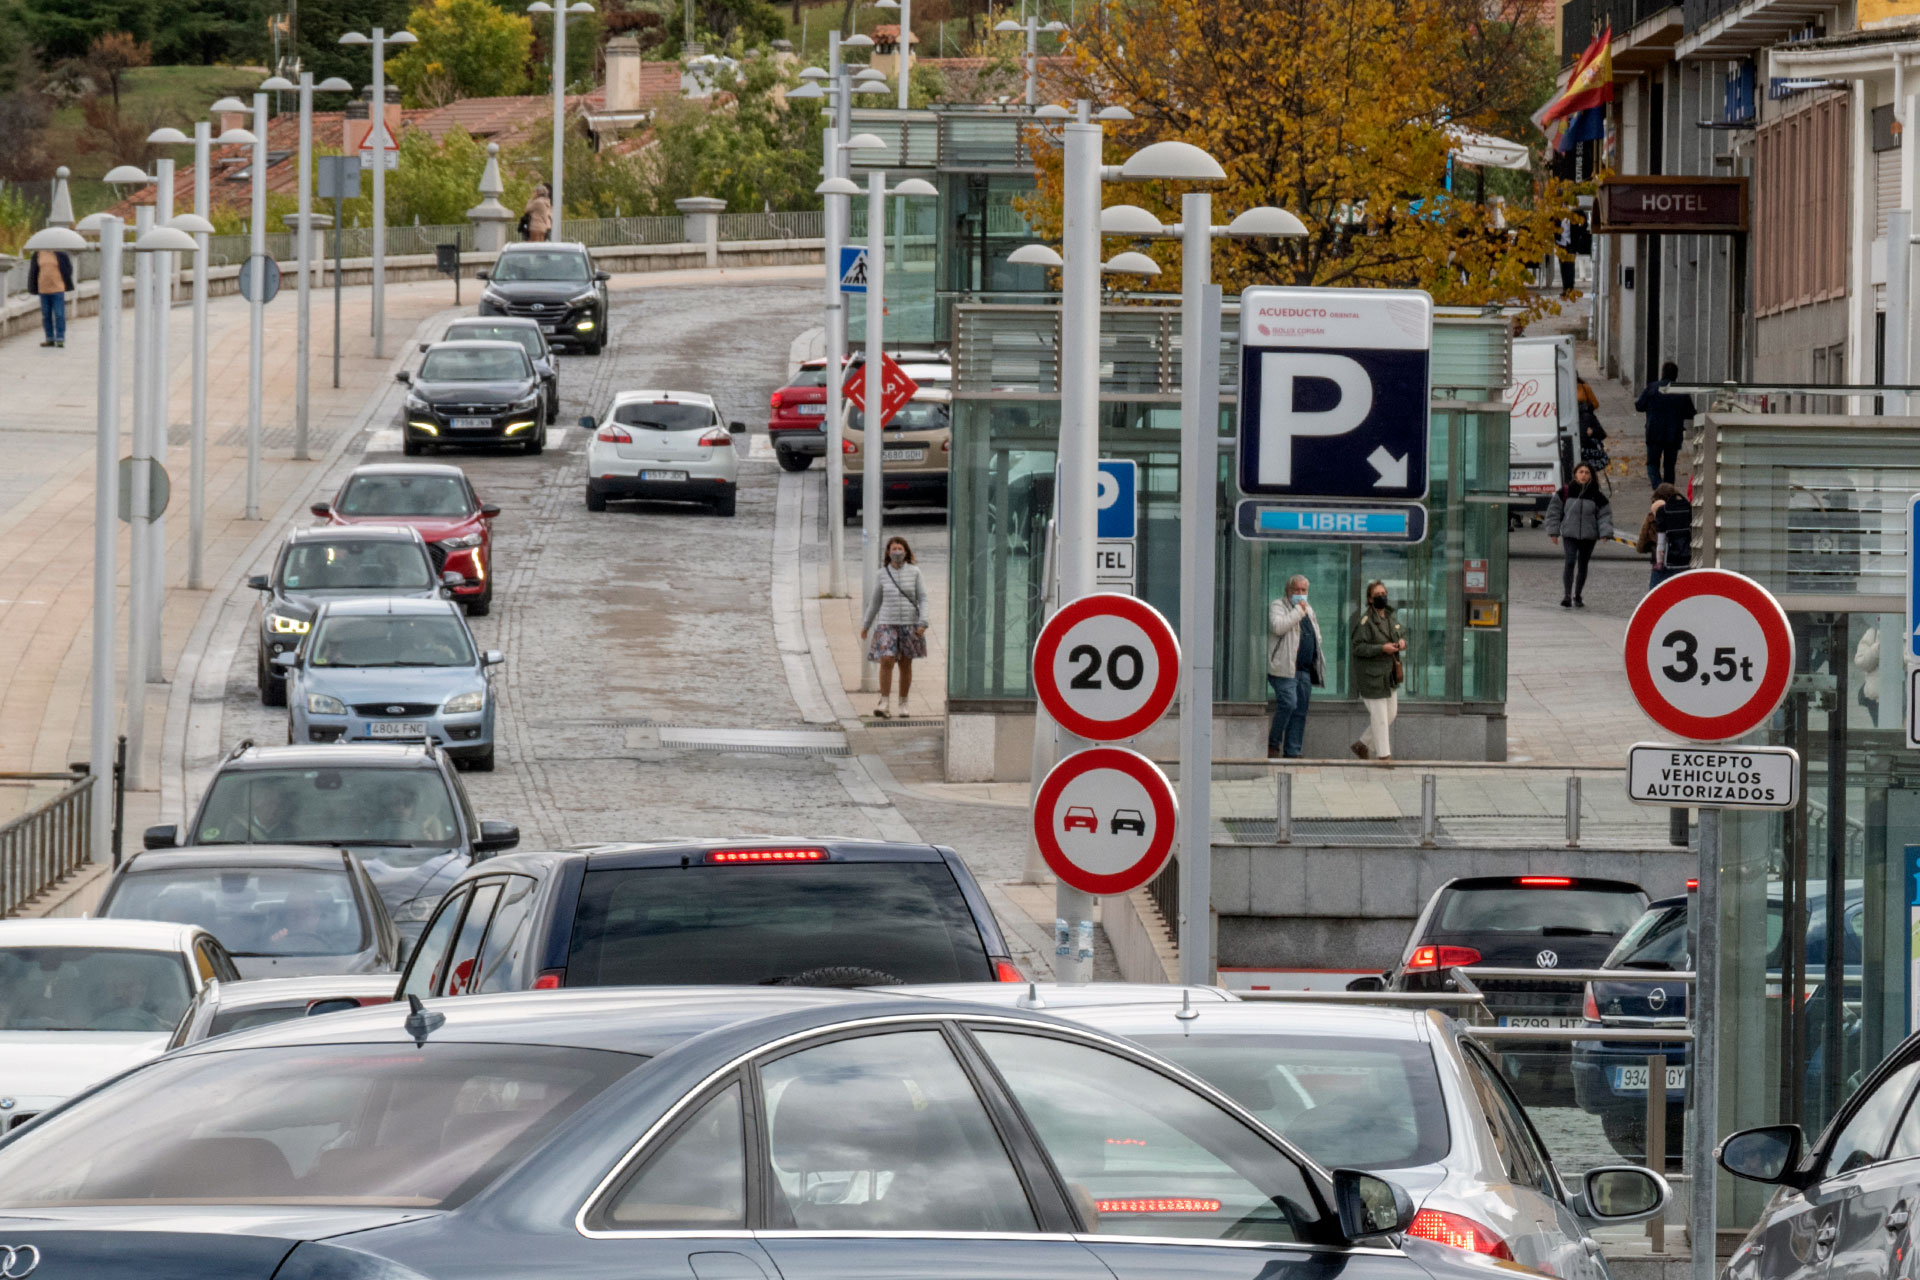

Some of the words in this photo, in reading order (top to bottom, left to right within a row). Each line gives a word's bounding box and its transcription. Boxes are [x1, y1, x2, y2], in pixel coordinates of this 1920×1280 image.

[1642, 194, 1708, 211] HOTEL
[1259, 307, 1327, 318] ACUEDUCTO
[1258, 352, 1373, 486] P
[1512, 471, 1530, 481] 2271
[1533, 471, 1548, 481] JZY
[1298, 512, 1369, 532] LIBRE
[1097, 551, 1126, 569] TEL
[1662, 629, 1754, 686] 3,5t
[1069, 644, 1144, 691] 20
[372, 723, 400, 734] 4804
[402, 723, 424, 734] FNC
[1671, 753, 1753, 769] EXCEPTO
[1661, 769, 1762, 785] VEHICULOS
[1646, 783, 1776, 801] AUTORIZADOS
[1511, 1018, 1550, 1028] 6799
[1560, 1018, 1583, 1028] HT
[1624, 1069, 1647, 1086] 934
[1665, 1069, 1685, 1086] GY
